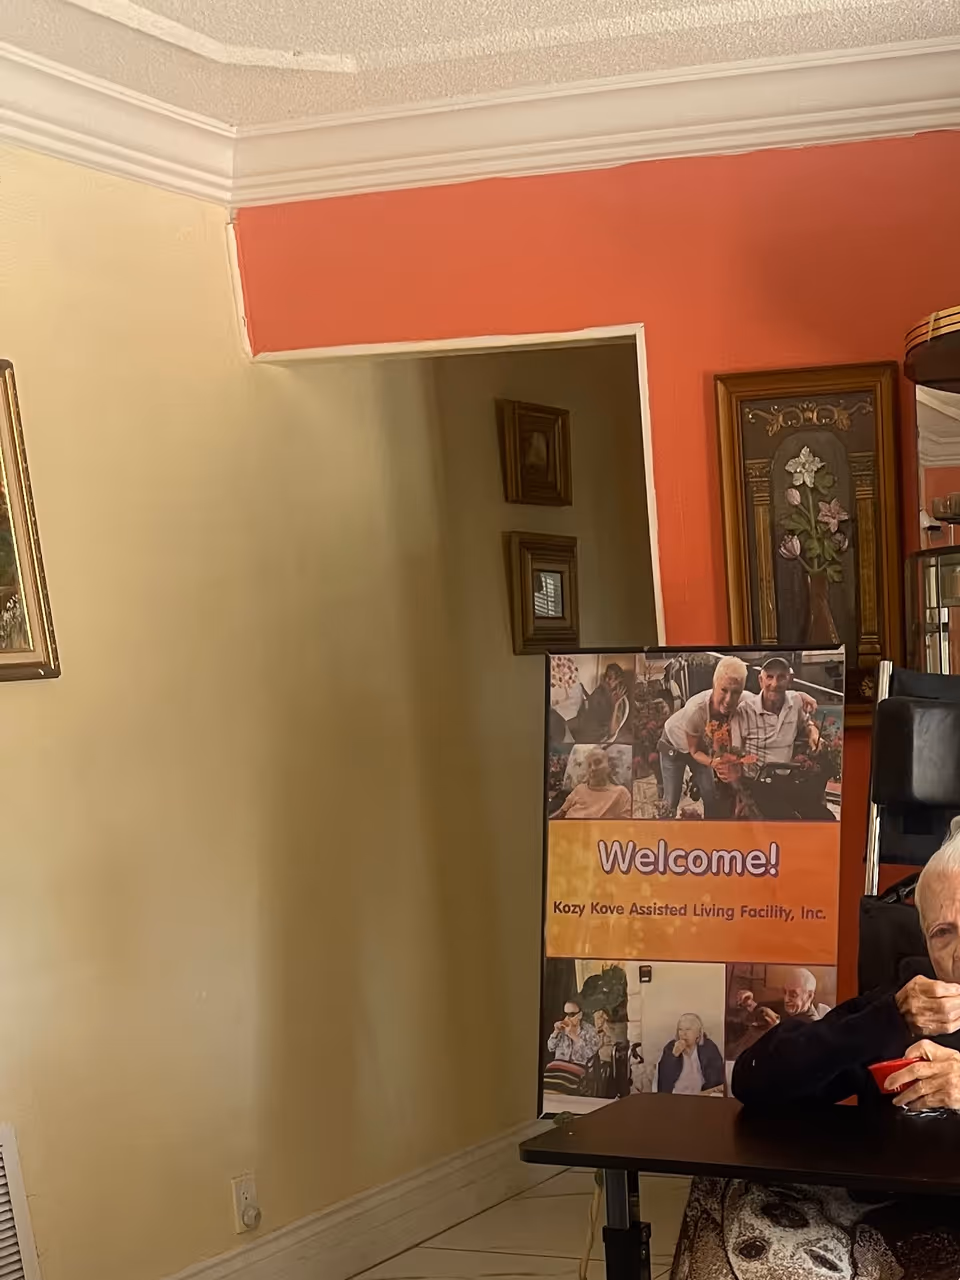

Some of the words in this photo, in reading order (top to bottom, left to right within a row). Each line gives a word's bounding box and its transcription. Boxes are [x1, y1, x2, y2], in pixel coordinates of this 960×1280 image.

[597, 838, 780, 878] Welcome!
[553, 901, 585, 917] Kozy
[590, 902, 624, 916] Kove
[629, 902, 687, 917] Assisted
[693, 904, 735, 921] Living
[740, 905, 795, 922] Facility,
[801, 906, 827, 920] Inc.
